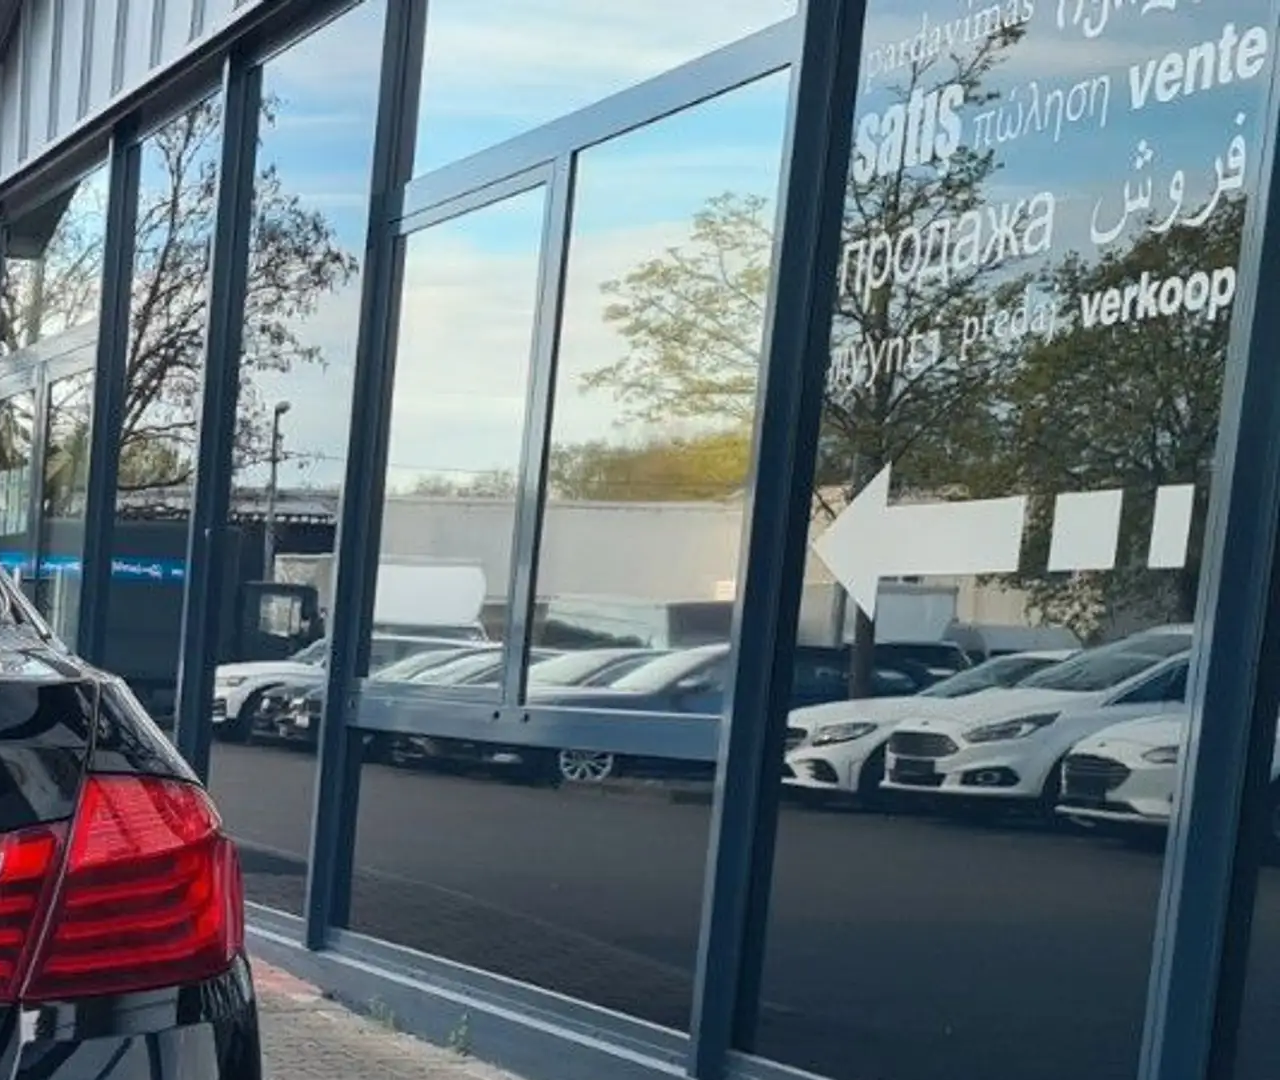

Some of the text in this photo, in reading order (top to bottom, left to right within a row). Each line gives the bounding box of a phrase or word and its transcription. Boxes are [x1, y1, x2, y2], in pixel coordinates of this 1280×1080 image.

[1128, 22, 1269, 110] vente
[972, 74, 1112, 150] πώληση
[1091, 112, 1246, 244] فروش
[839, 191, 1056, 314] продажа
[1080, 266, 1237, 328] verkoop
